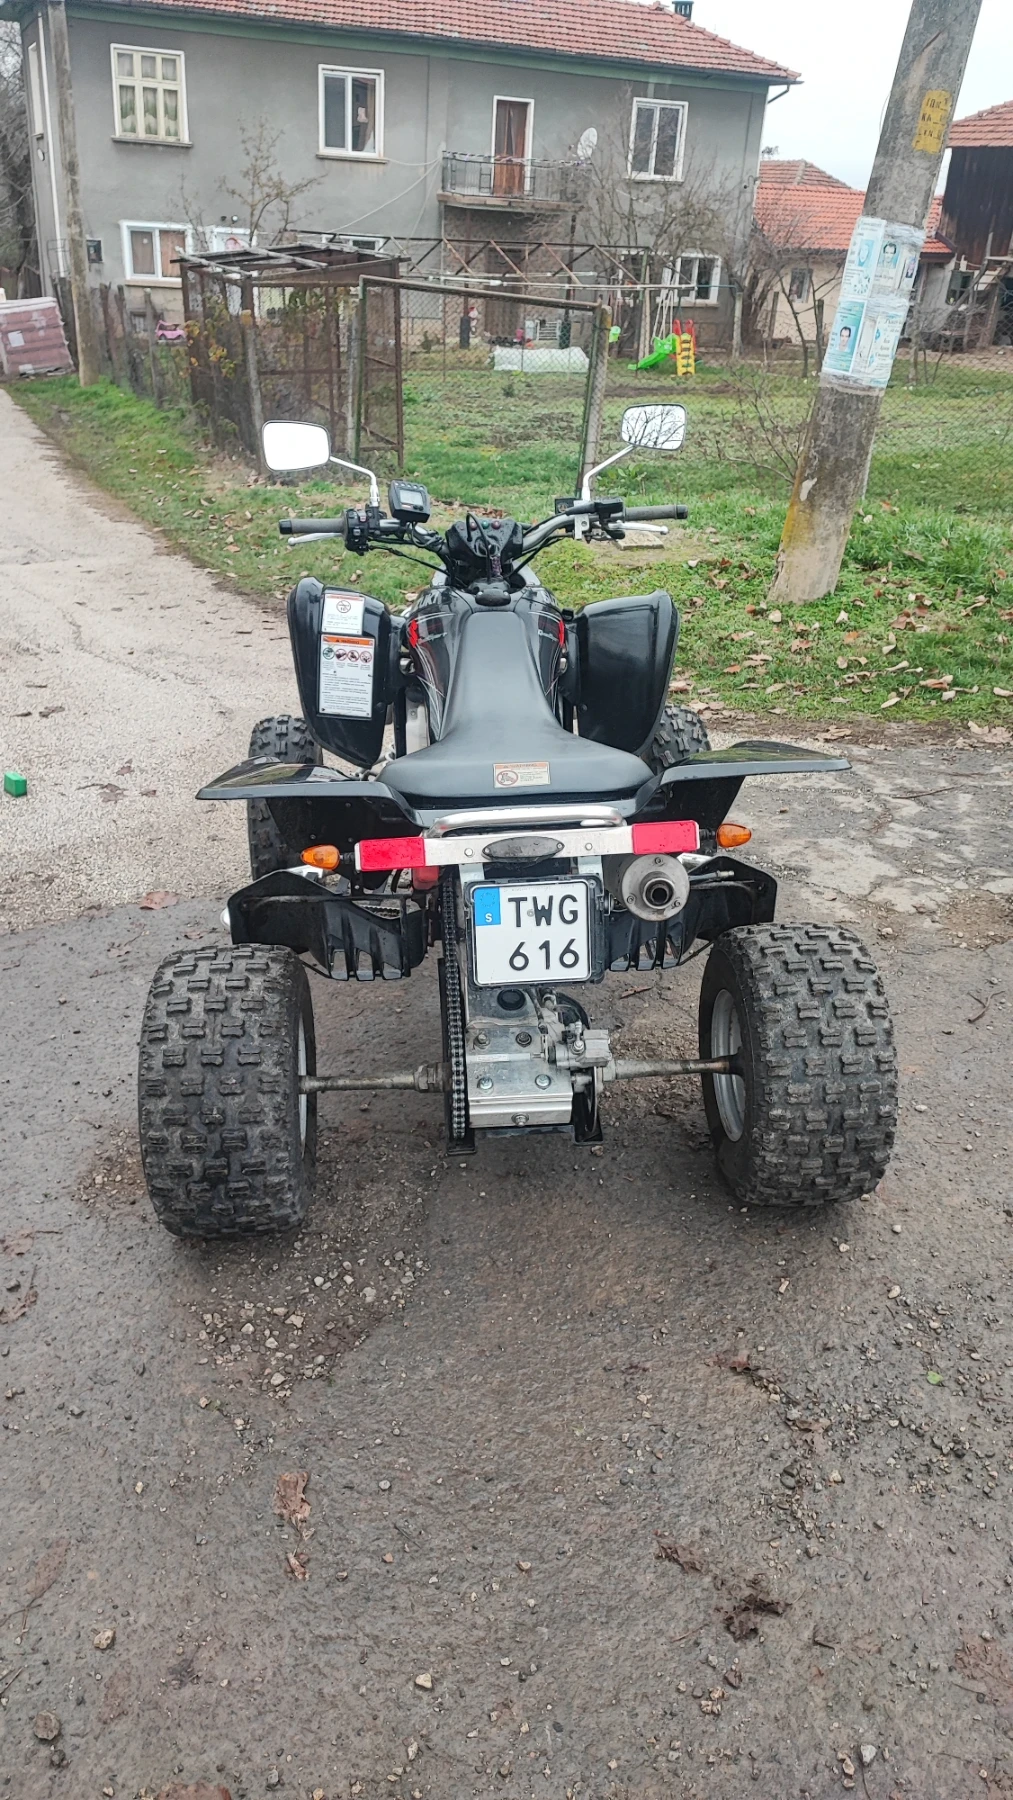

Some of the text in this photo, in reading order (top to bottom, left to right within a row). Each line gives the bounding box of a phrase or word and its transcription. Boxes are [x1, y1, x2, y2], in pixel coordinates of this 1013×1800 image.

[485, 912, 493, 923] S
[507, 894, 579, 928] TWG
[508, 938, 580, 972] 616
